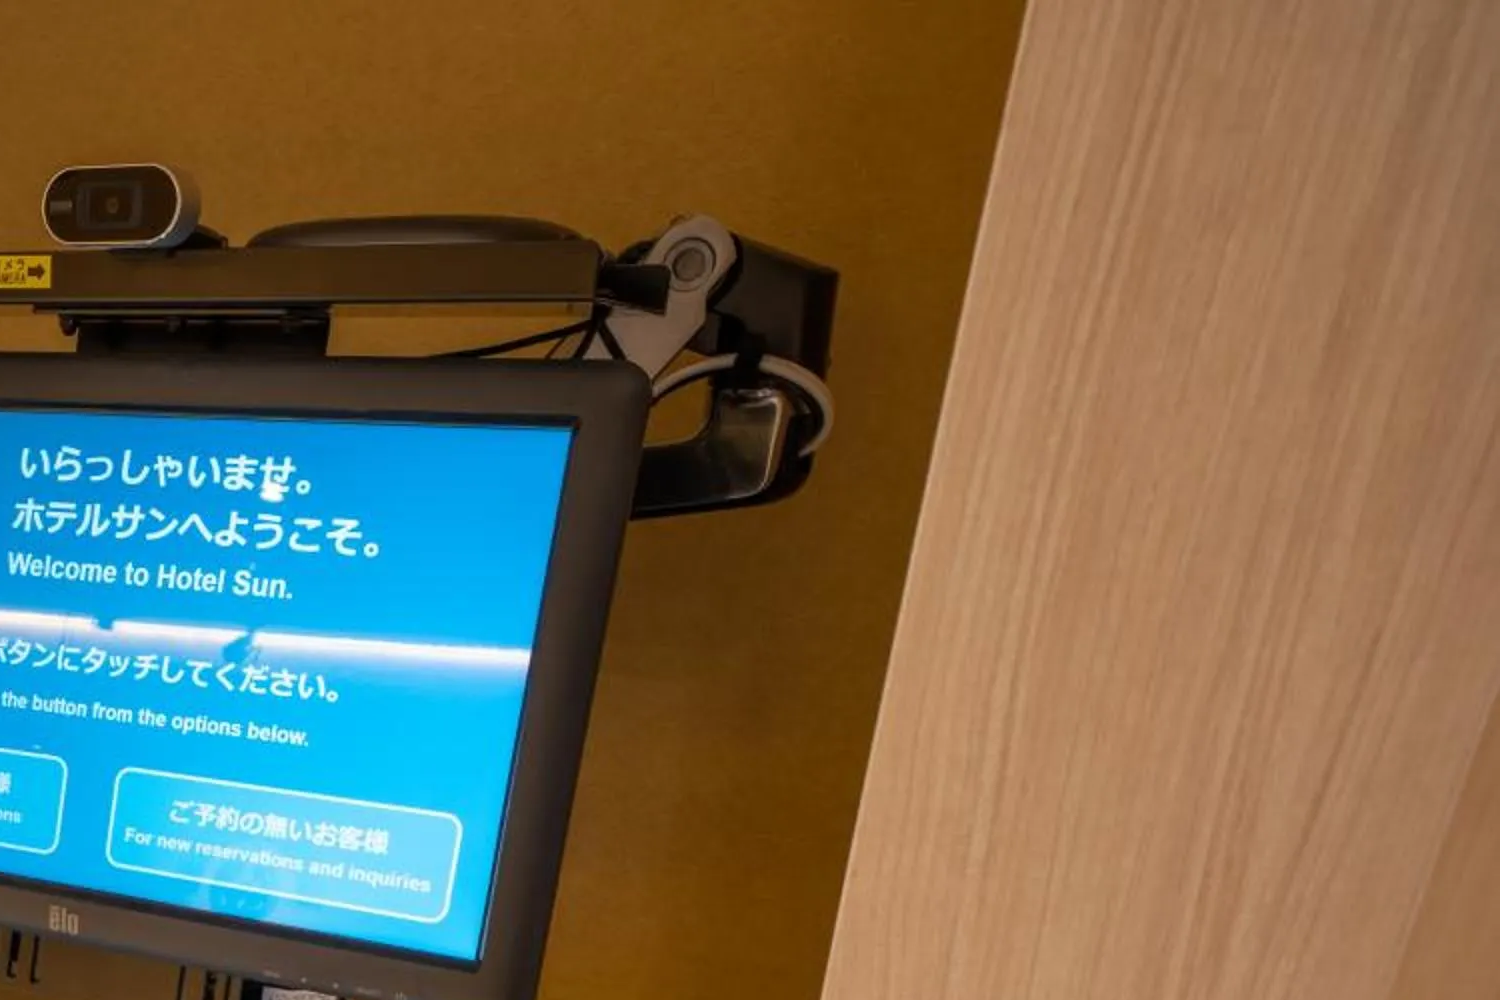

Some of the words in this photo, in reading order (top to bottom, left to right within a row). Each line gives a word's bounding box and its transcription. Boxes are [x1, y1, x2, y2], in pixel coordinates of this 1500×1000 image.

[19, 445, 312, 497] いらっしゃいませ。
[12, 497, 380, 558] ホテルサンへようこそ。
[7, 551, 118, 583] Welcome
[124, 562, 150, 587] to
[156, 564, 226, 594] Hotel
[232, 570, 294, 600] Sun.
[1, 690, 28, 710] the
[32, 694, 87, 719] button
[93, 701, 133, 724] from
[137, 707, 166, 728] the
[171, 713, 242, 738] options
[247, 720, 309, 748] below.
[168, 799, 389, 856] ご予約の無いお客様
[123, 826, 156, 845] For
[156, 833, 190, 853] new
[195, 841, 303, 872] reservations
[308, 861, 344, 879] and
[348, 864, 431, 893] inquiries
